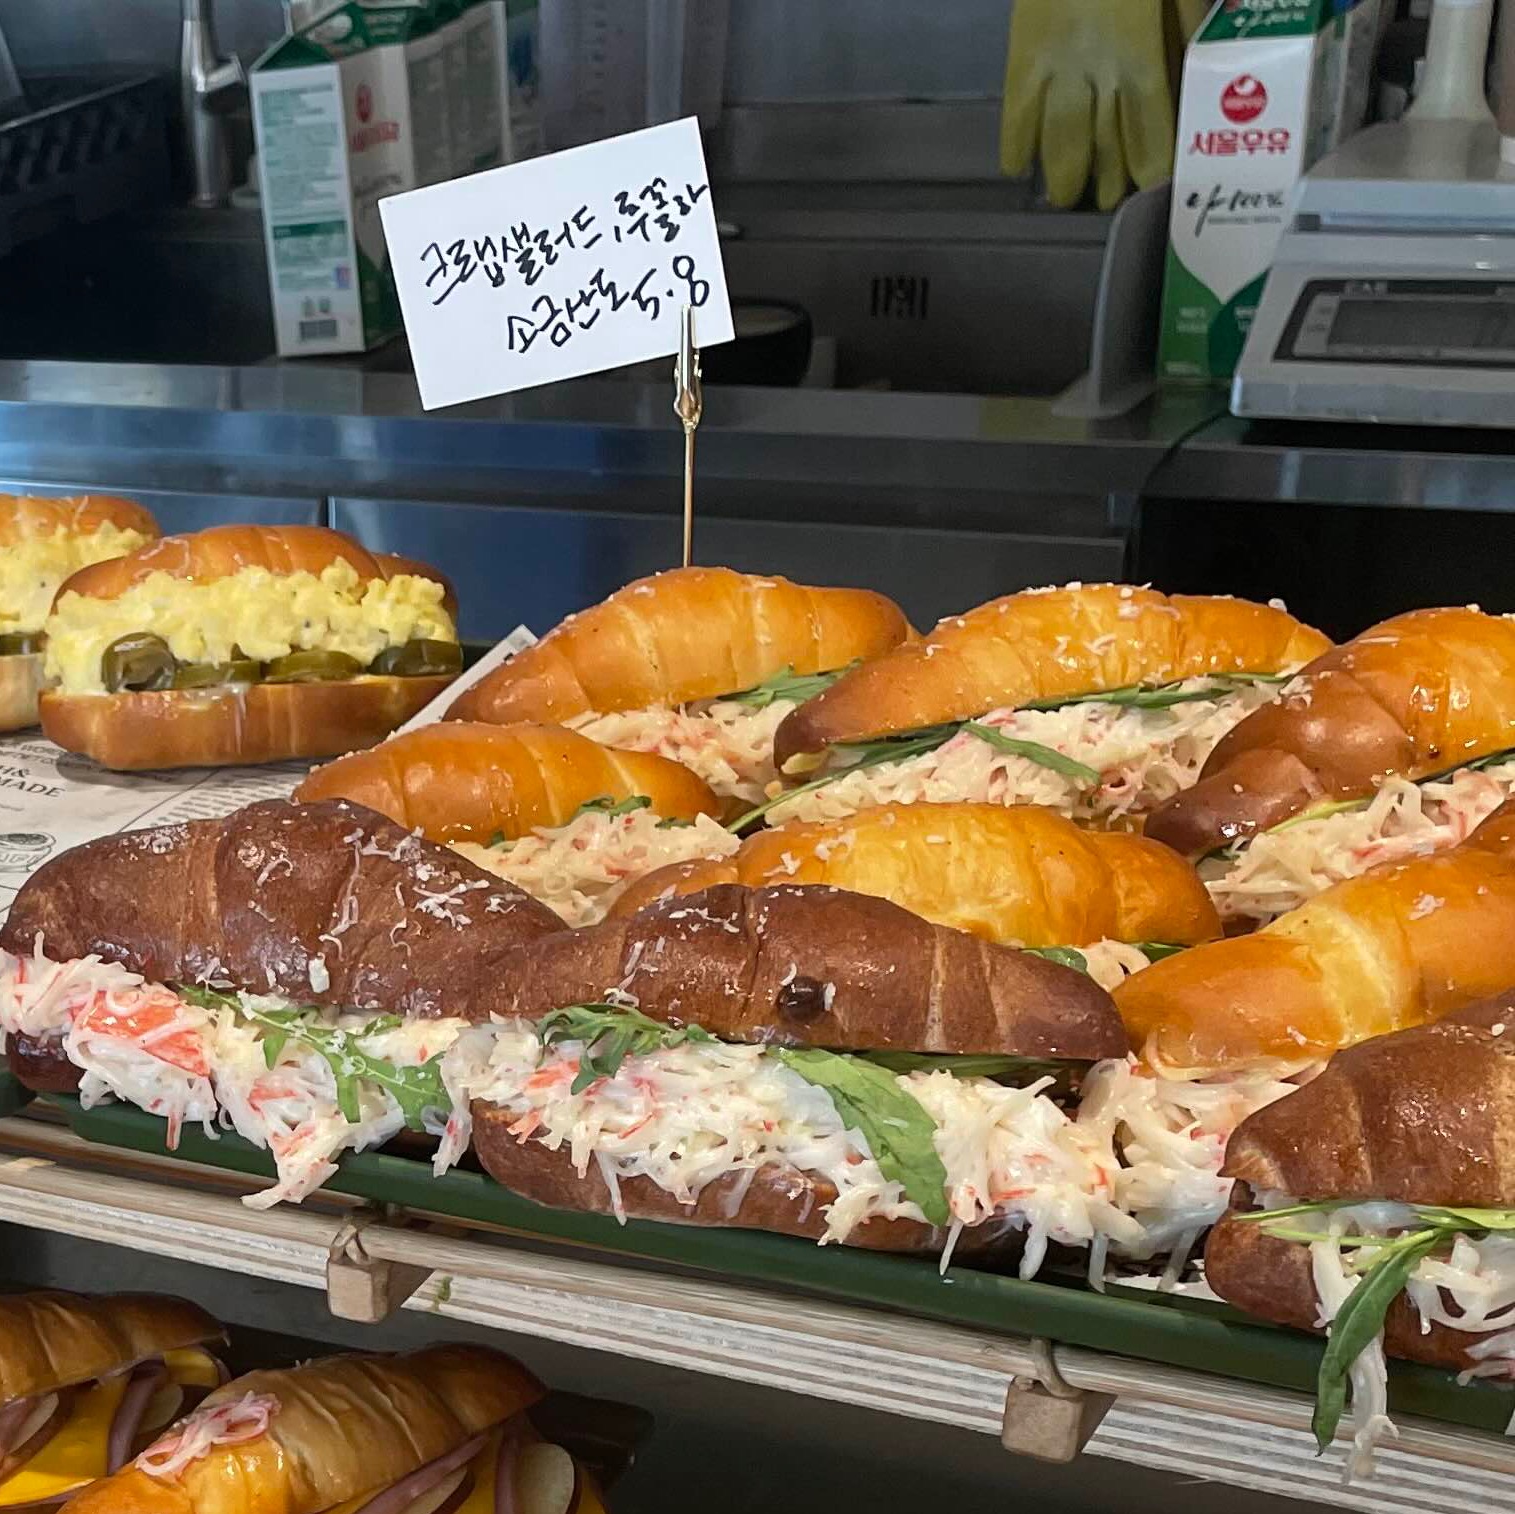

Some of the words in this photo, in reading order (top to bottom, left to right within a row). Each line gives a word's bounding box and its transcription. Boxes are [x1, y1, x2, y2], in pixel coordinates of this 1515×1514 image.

[1189, 127, 1291, 157] 서울우유
[507, 268, 629, 353] 소금산도
[632, 254, 710, 321] 5.8
